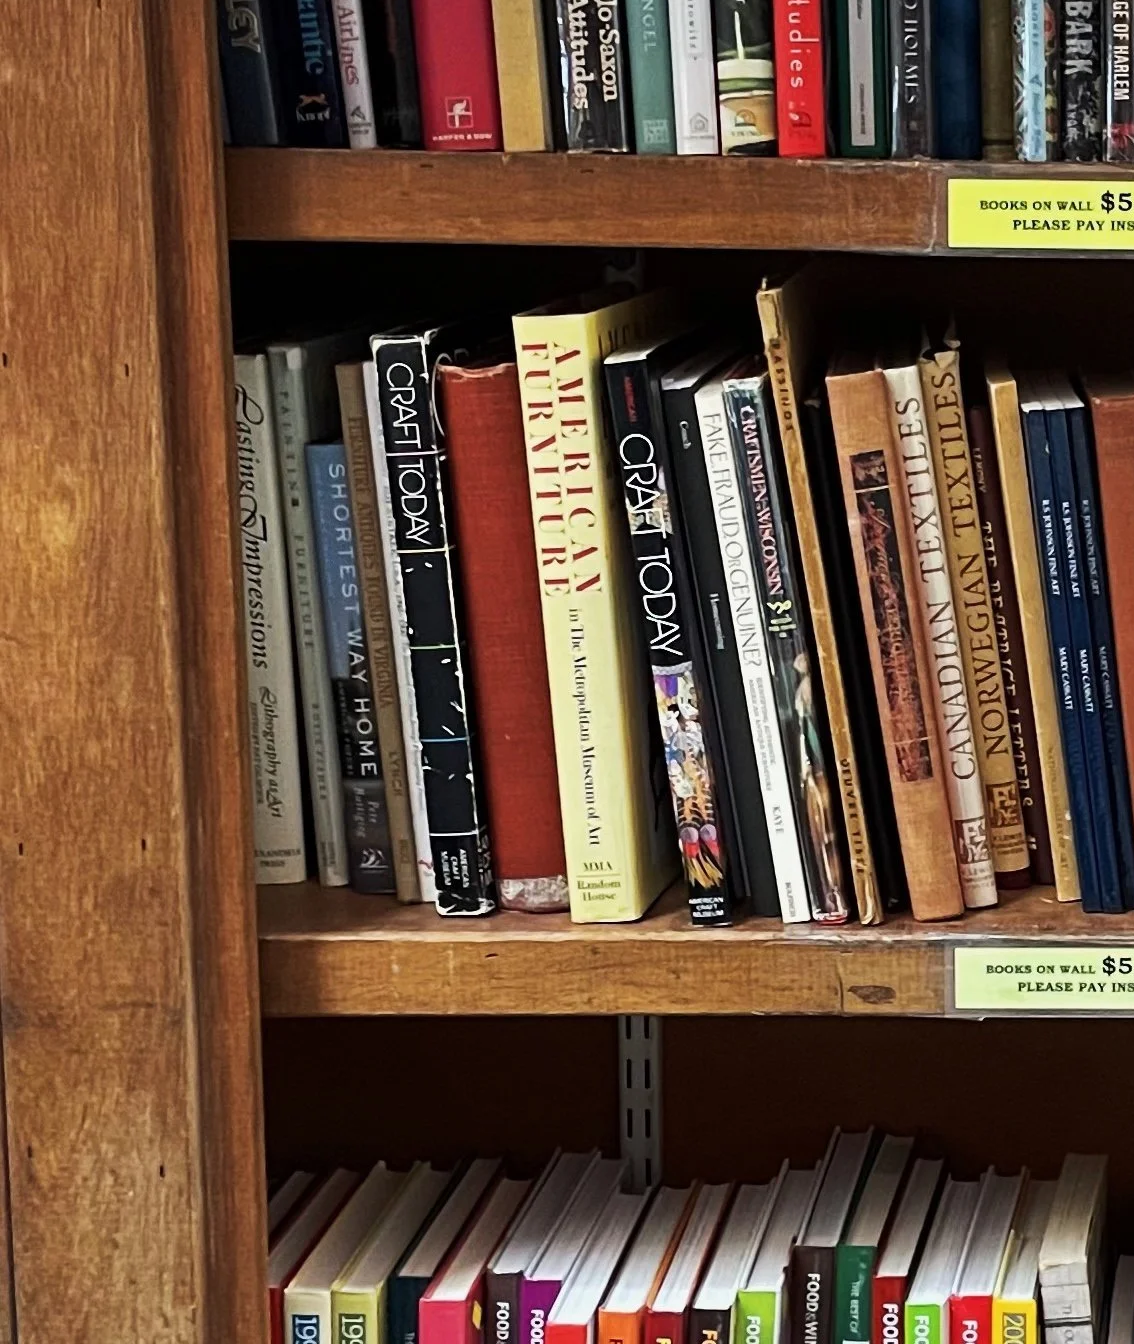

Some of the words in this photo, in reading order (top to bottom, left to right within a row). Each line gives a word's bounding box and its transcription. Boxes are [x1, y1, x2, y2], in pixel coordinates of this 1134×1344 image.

[1066, 1, 1093, 75] BARK
[979, 200, 1027, 211] BOOKS
[1032, 200, 1052, 211] ON
[1057, 201, 1093, 211] WALL
[1101, 191, 1132, 213] $5
[1013, 220, 1070, 231] PLEASE
[1076, 220, 1104, 231] PAY
[521, 342, 568, 598] FURNITURE
[553, 344, 602, 594] AMERICAN
[930, 374, 977, 537] TEXTILES
[619, 434, 664, 539] CRAFT
[568, 607, 585, 622] in
[636, 548, 682, 656] TODAY
[570, 625, 588, 652] The
[958, 555, 1010, 759] NORWEGIAN
[572, 656, 593, 742] Metropolitan
[578, 746, 597, 802] Museum
[585, 806, 602, 821] of
[587, 824, 603, 847] Art
[987, 965, 1032, 974] BOOKS
[1036, 965, 1055, 974] ON
[1060, 965, 1095, 974] WALL
[1102, 956, 1132, 976] $5
[1018, 983, 1073, 993] PLEASE
[1079, 983, 1106, 993] PAY
